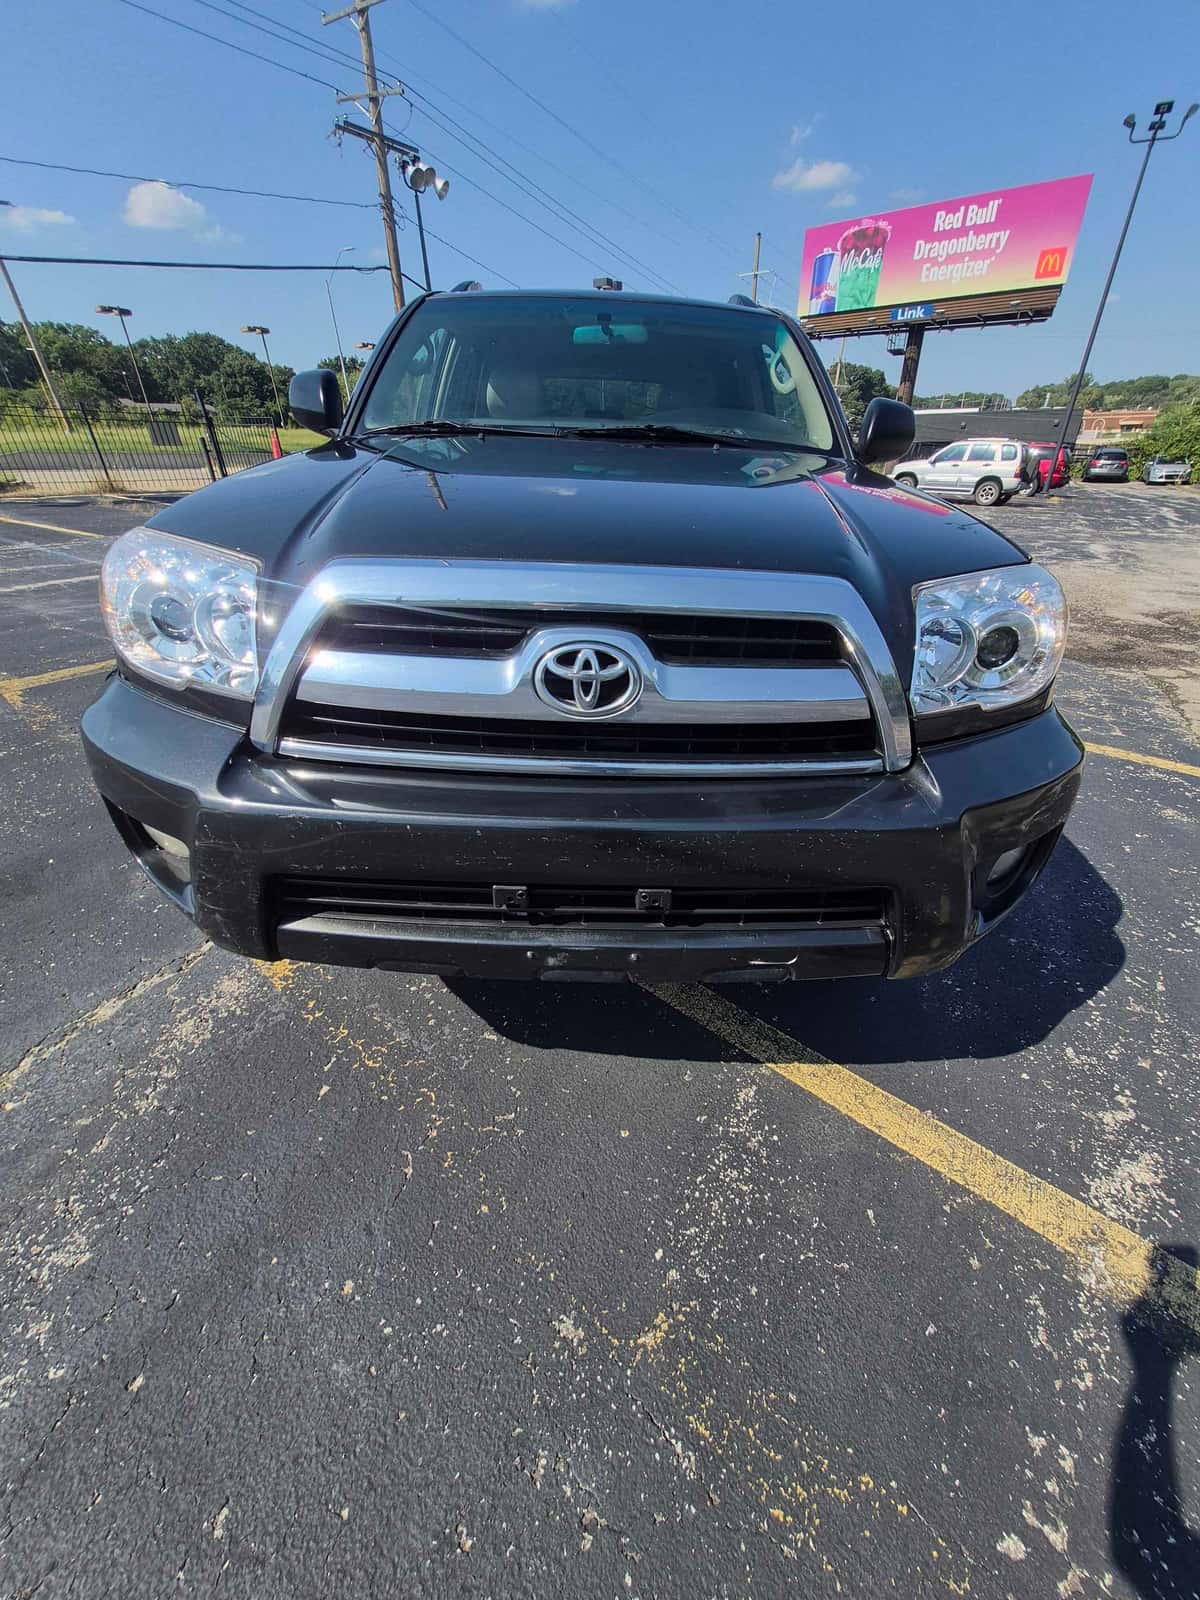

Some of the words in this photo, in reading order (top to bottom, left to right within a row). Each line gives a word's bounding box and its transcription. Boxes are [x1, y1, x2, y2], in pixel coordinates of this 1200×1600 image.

[933, 206, 965, 232] Red
[965, 199, 999, 227] Bull
[913, 230, 1011, 262] Dragonberry
[920, 257, 991, 284] Energizer
[897, 306, 925, 320] Link
